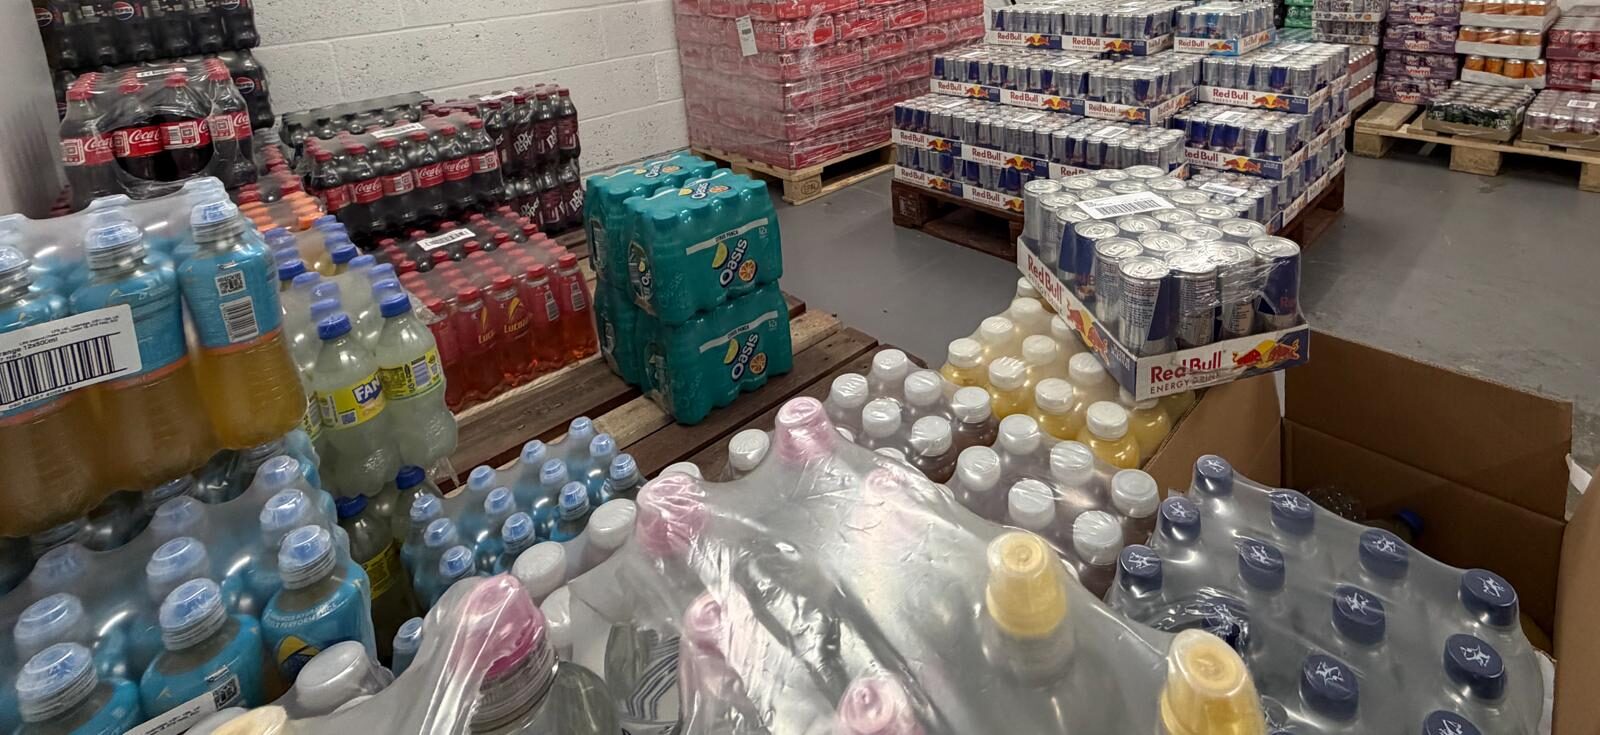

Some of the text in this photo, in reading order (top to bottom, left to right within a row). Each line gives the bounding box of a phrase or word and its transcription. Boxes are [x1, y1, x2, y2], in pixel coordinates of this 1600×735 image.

[997, 32, 1022, 42] Red Bull
[1072, 37, 1100, 46] Red Bull
[1192, 40, 1204, 48] Bull
[938, 81, 962, 91] Red Bull
[1010, 91, 1038, 102] Red Bull
[1213, 88, 1249, 100] Red Bull
[1088, 103, 1116, 113] Red Bull
[900, 132, 913, 141] Red
[913, 134, 925, 144] Bull
[972, 148, 1000, 160] Red Bull
[1201, 150, 1218, 162] Bull
[901, 168, 925, 180] Red Bull
[1061, 166, 1078, 176] Red
[972, 188, 1000, 202] Red Bull
[720, 239, 747, 285] Oasis
[1027, 253, 1044, 281] Red
[1045, 272, 1062, 304] Bull
[732, 333, 758, 380] Oasis
[1151, 350, 1222, 384] Red Bull
[1150, 379, 1190, 395] ENERGY
